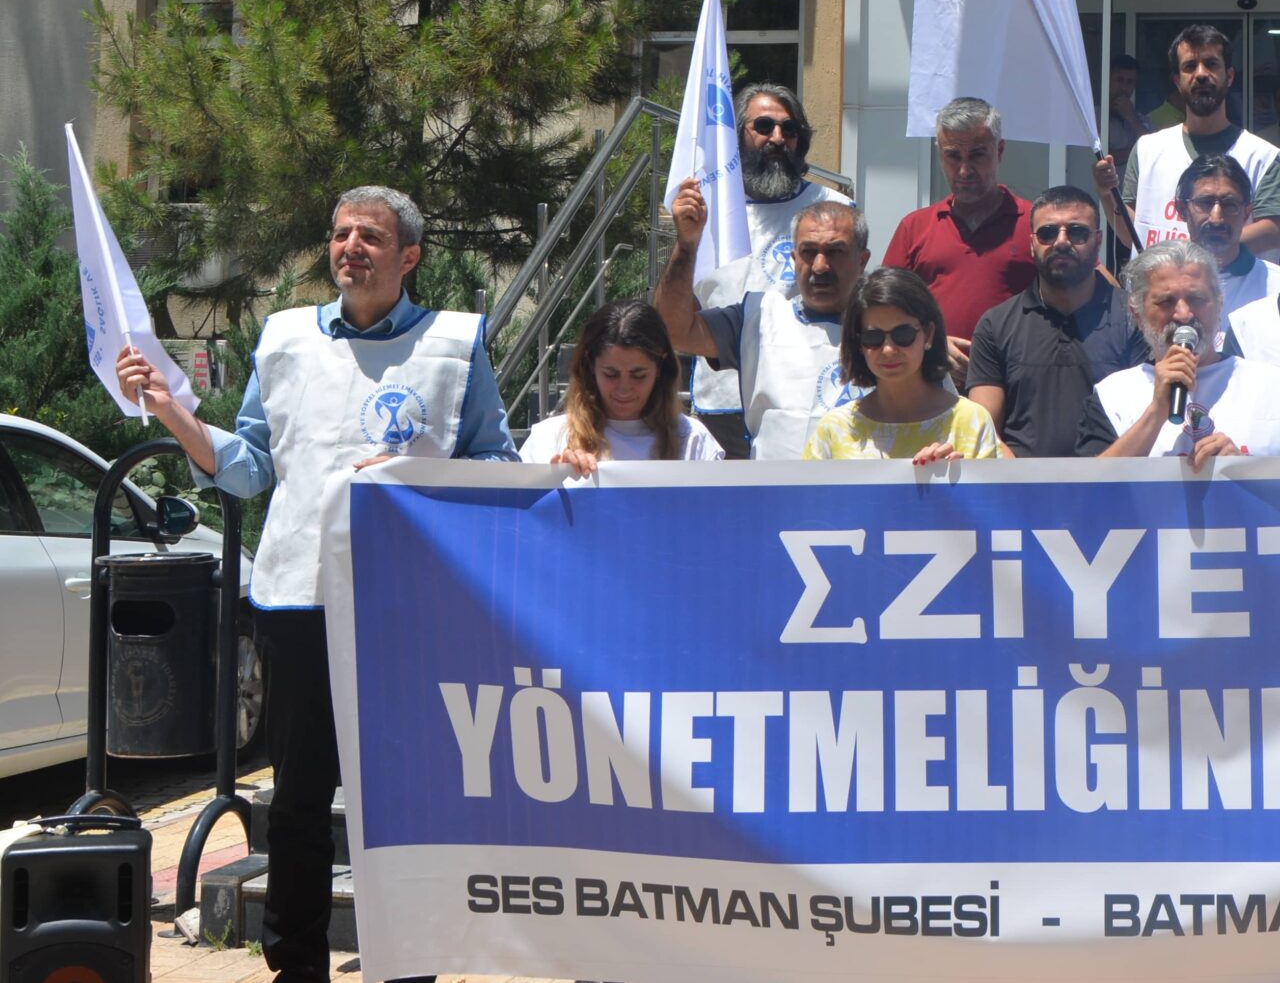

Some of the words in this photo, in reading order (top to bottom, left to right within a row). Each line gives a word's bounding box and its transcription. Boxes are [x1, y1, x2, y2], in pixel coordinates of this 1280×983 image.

[467, 874, 565, 916] SES
[574, 877, 799, 931] BATMAN
[809, 880, 1000, 947] ŞUBESİ
